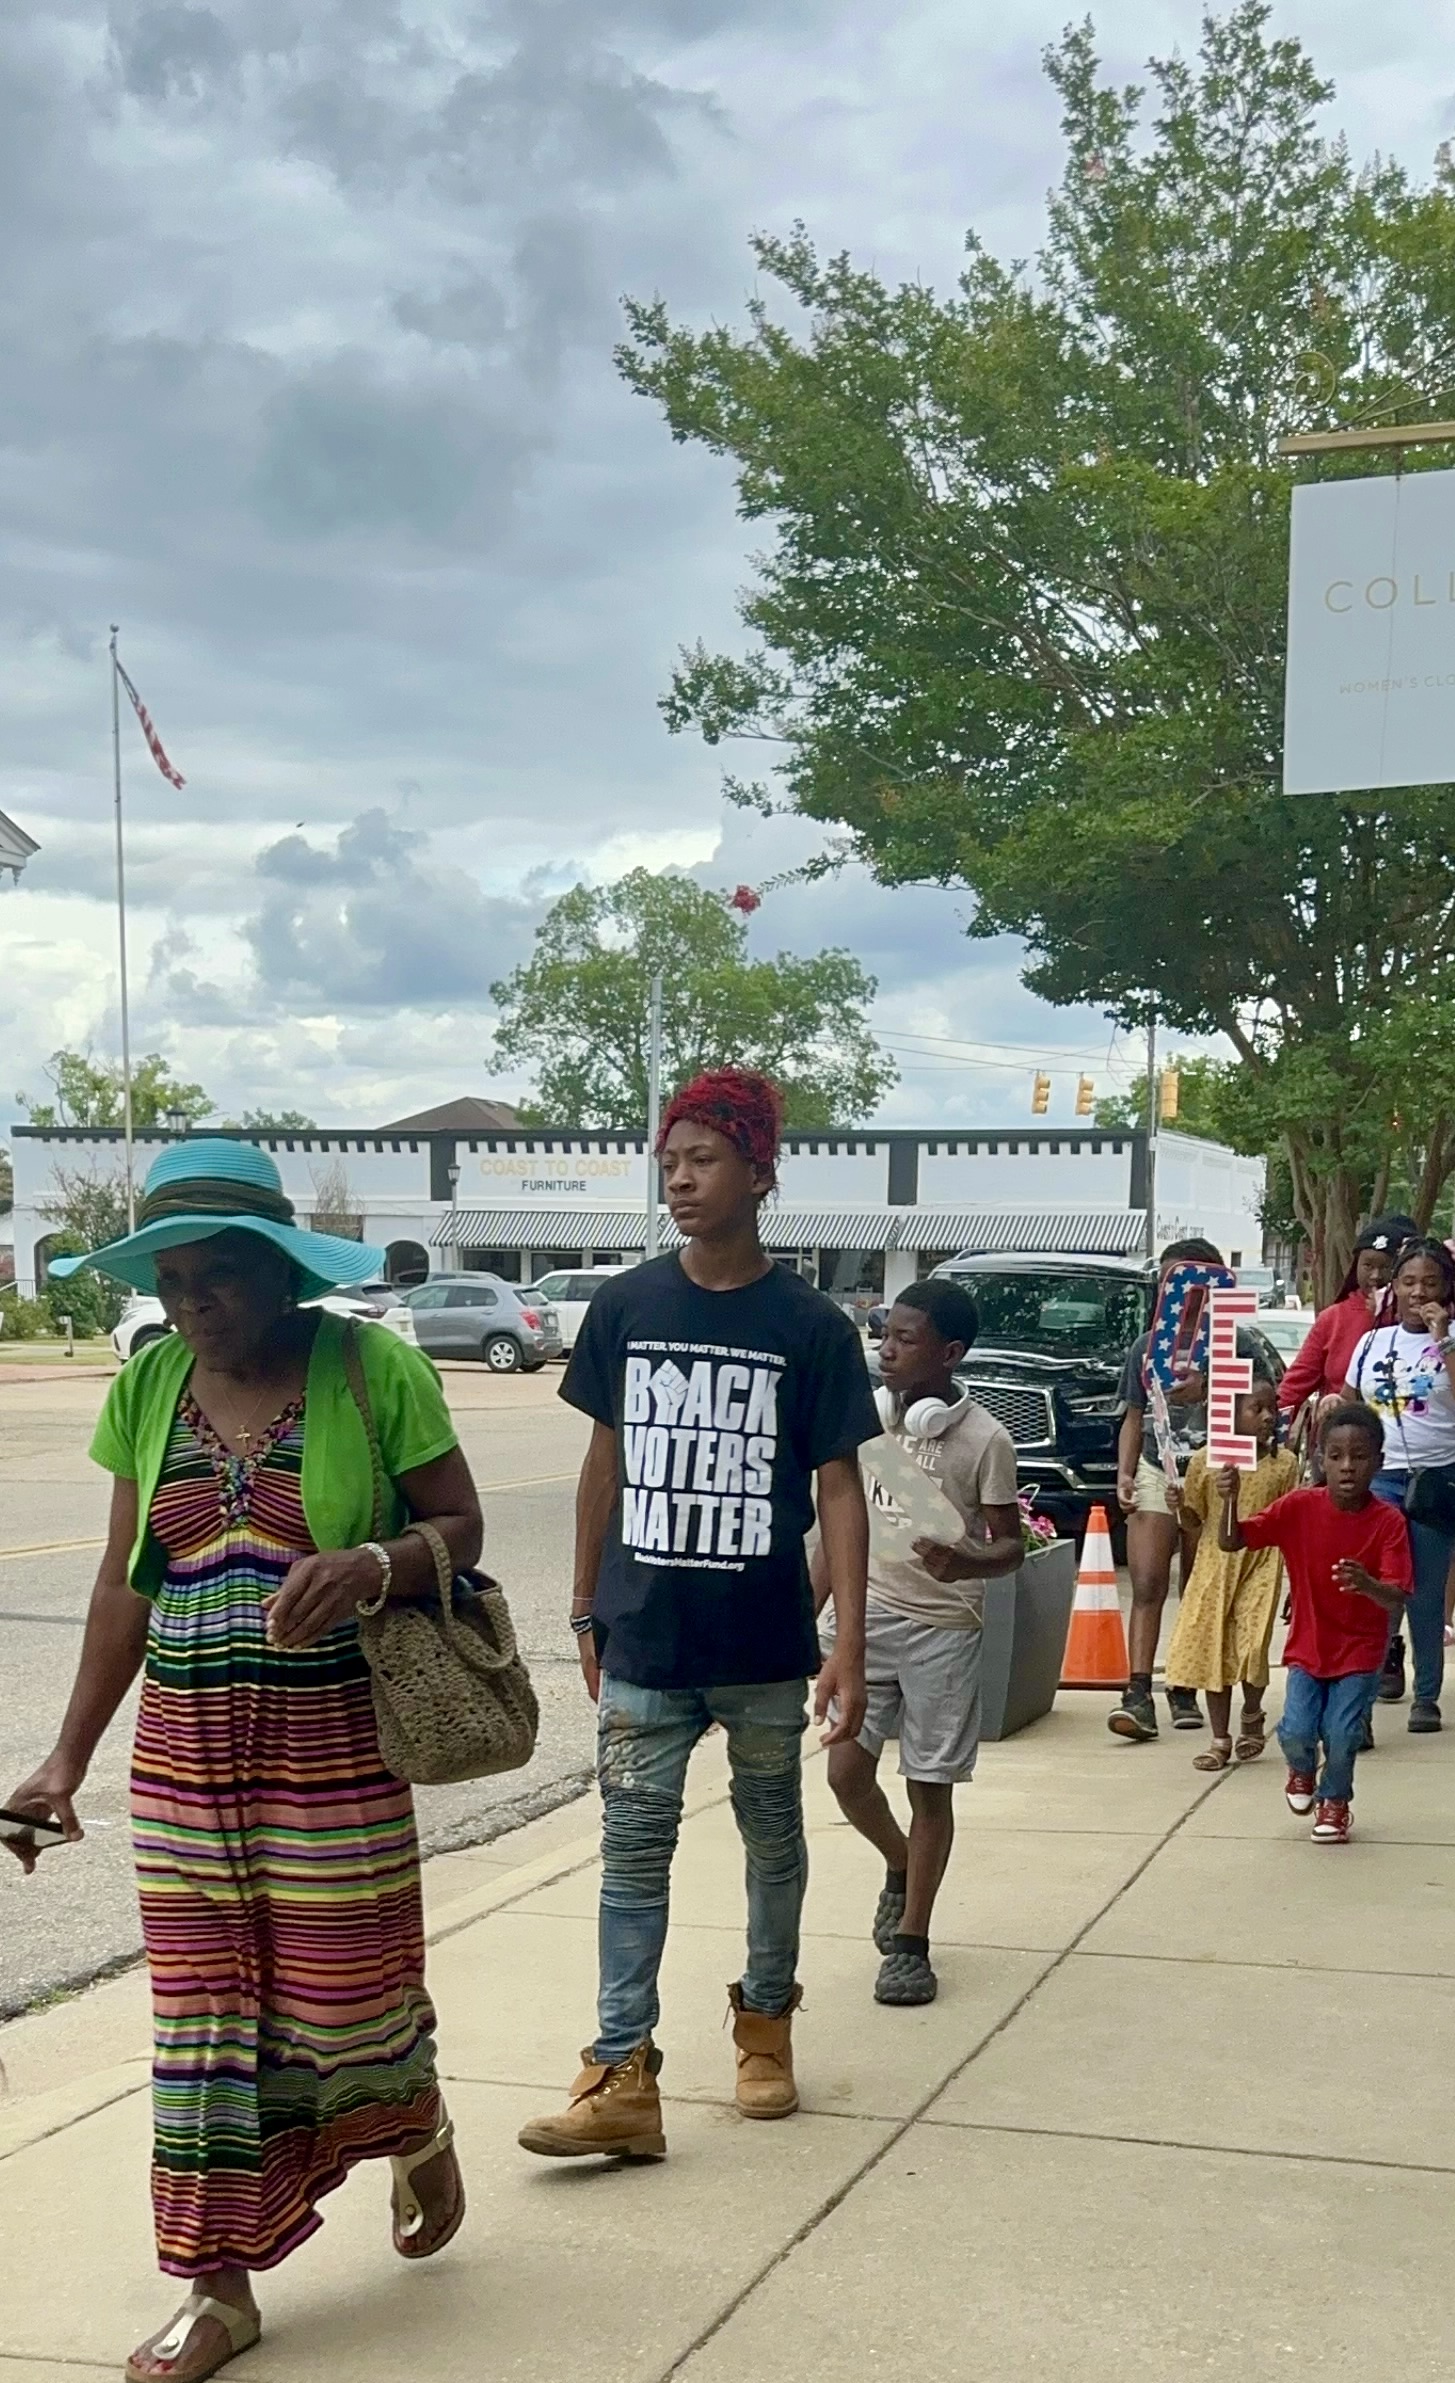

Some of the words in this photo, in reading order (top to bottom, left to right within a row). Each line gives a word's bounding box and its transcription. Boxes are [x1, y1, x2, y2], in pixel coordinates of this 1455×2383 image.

[1340, 677, 1418, 694] WOMEN'S
[479, 1159, 538, 1176] COAST
[544, 1159, 568, 1176] TO
[575, 1160, 632, 1176] COAST
[521, 1180, 586, 1191] FURNITURE
[667, 1342, 689, 1353] YOU
[730, 1347, 748, 1359] WE
[918, 1438, 945, 1454] ARE
[623, 1424, 776, 1496] VOTERS
[622, 1487, 773, 1556] MATTER
